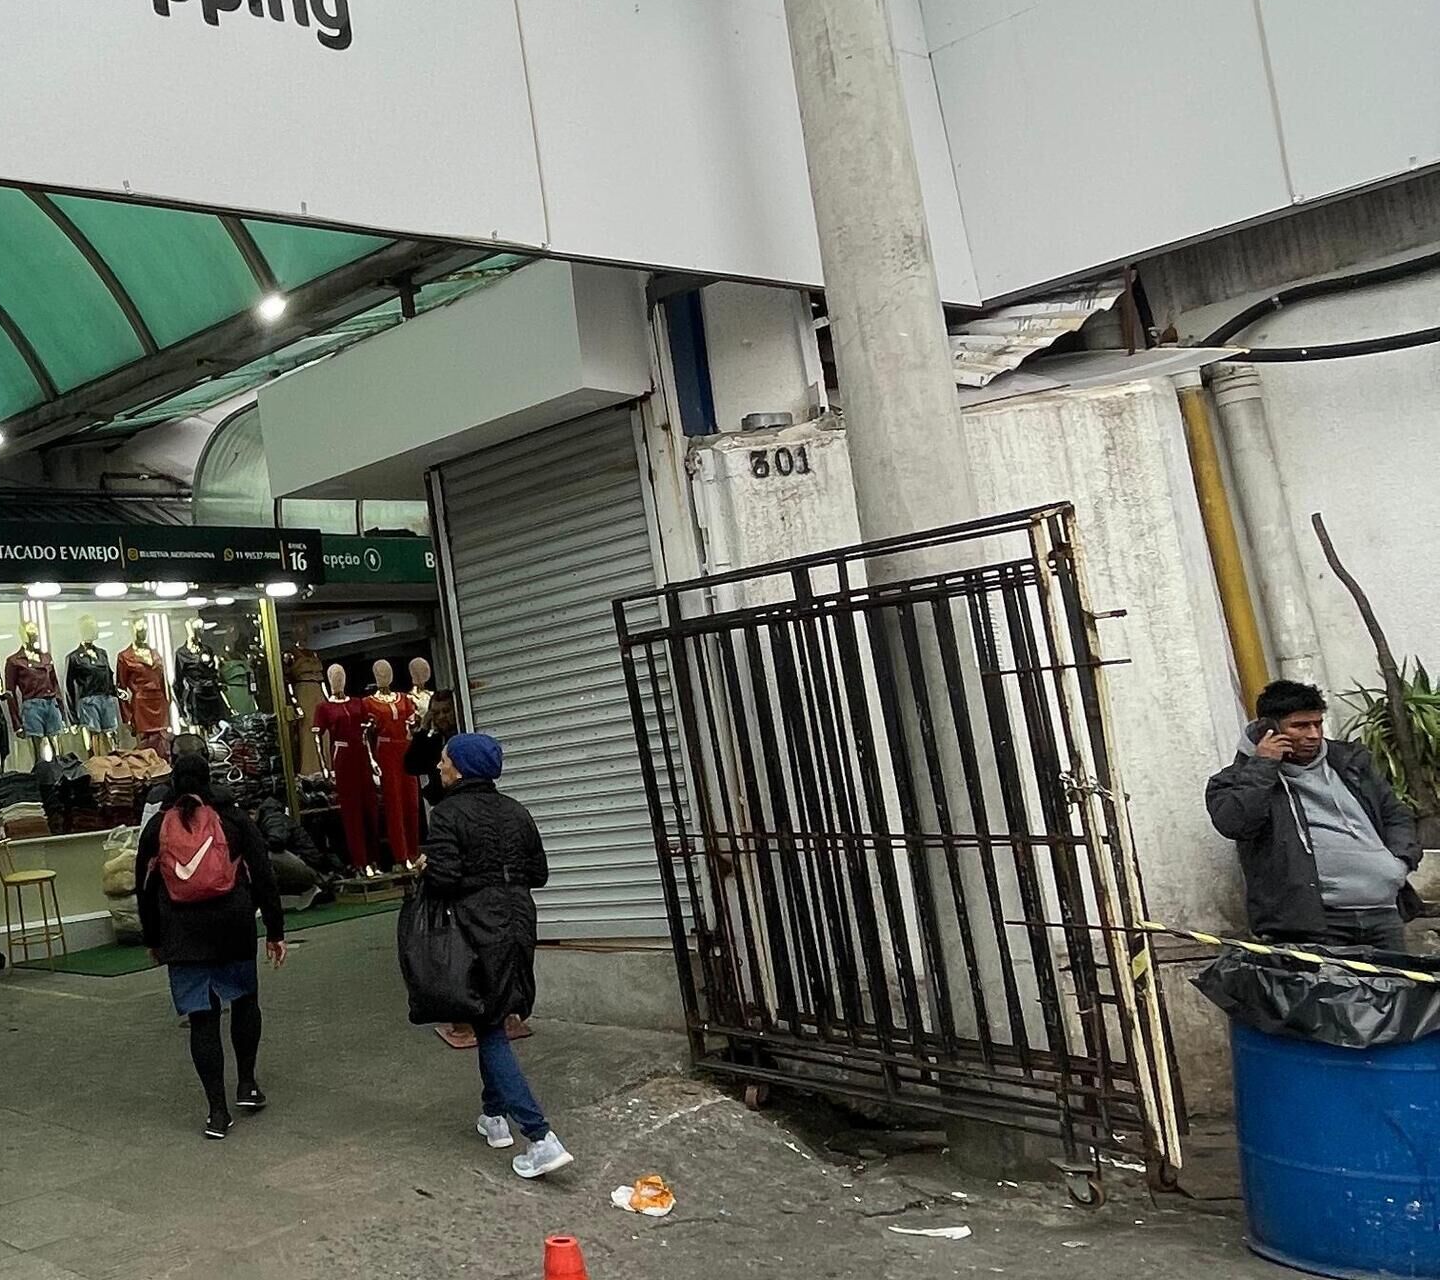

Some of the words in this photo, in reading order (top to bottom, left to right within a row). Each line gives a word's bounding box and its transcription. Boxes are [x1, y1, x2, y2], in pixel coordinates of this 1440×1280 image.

[59, 546, 68, 560] E
[68, 546, 120, 563] VAREJO
[289, 551, 308, 572] 16
[322, 551, 361, 569] epção
